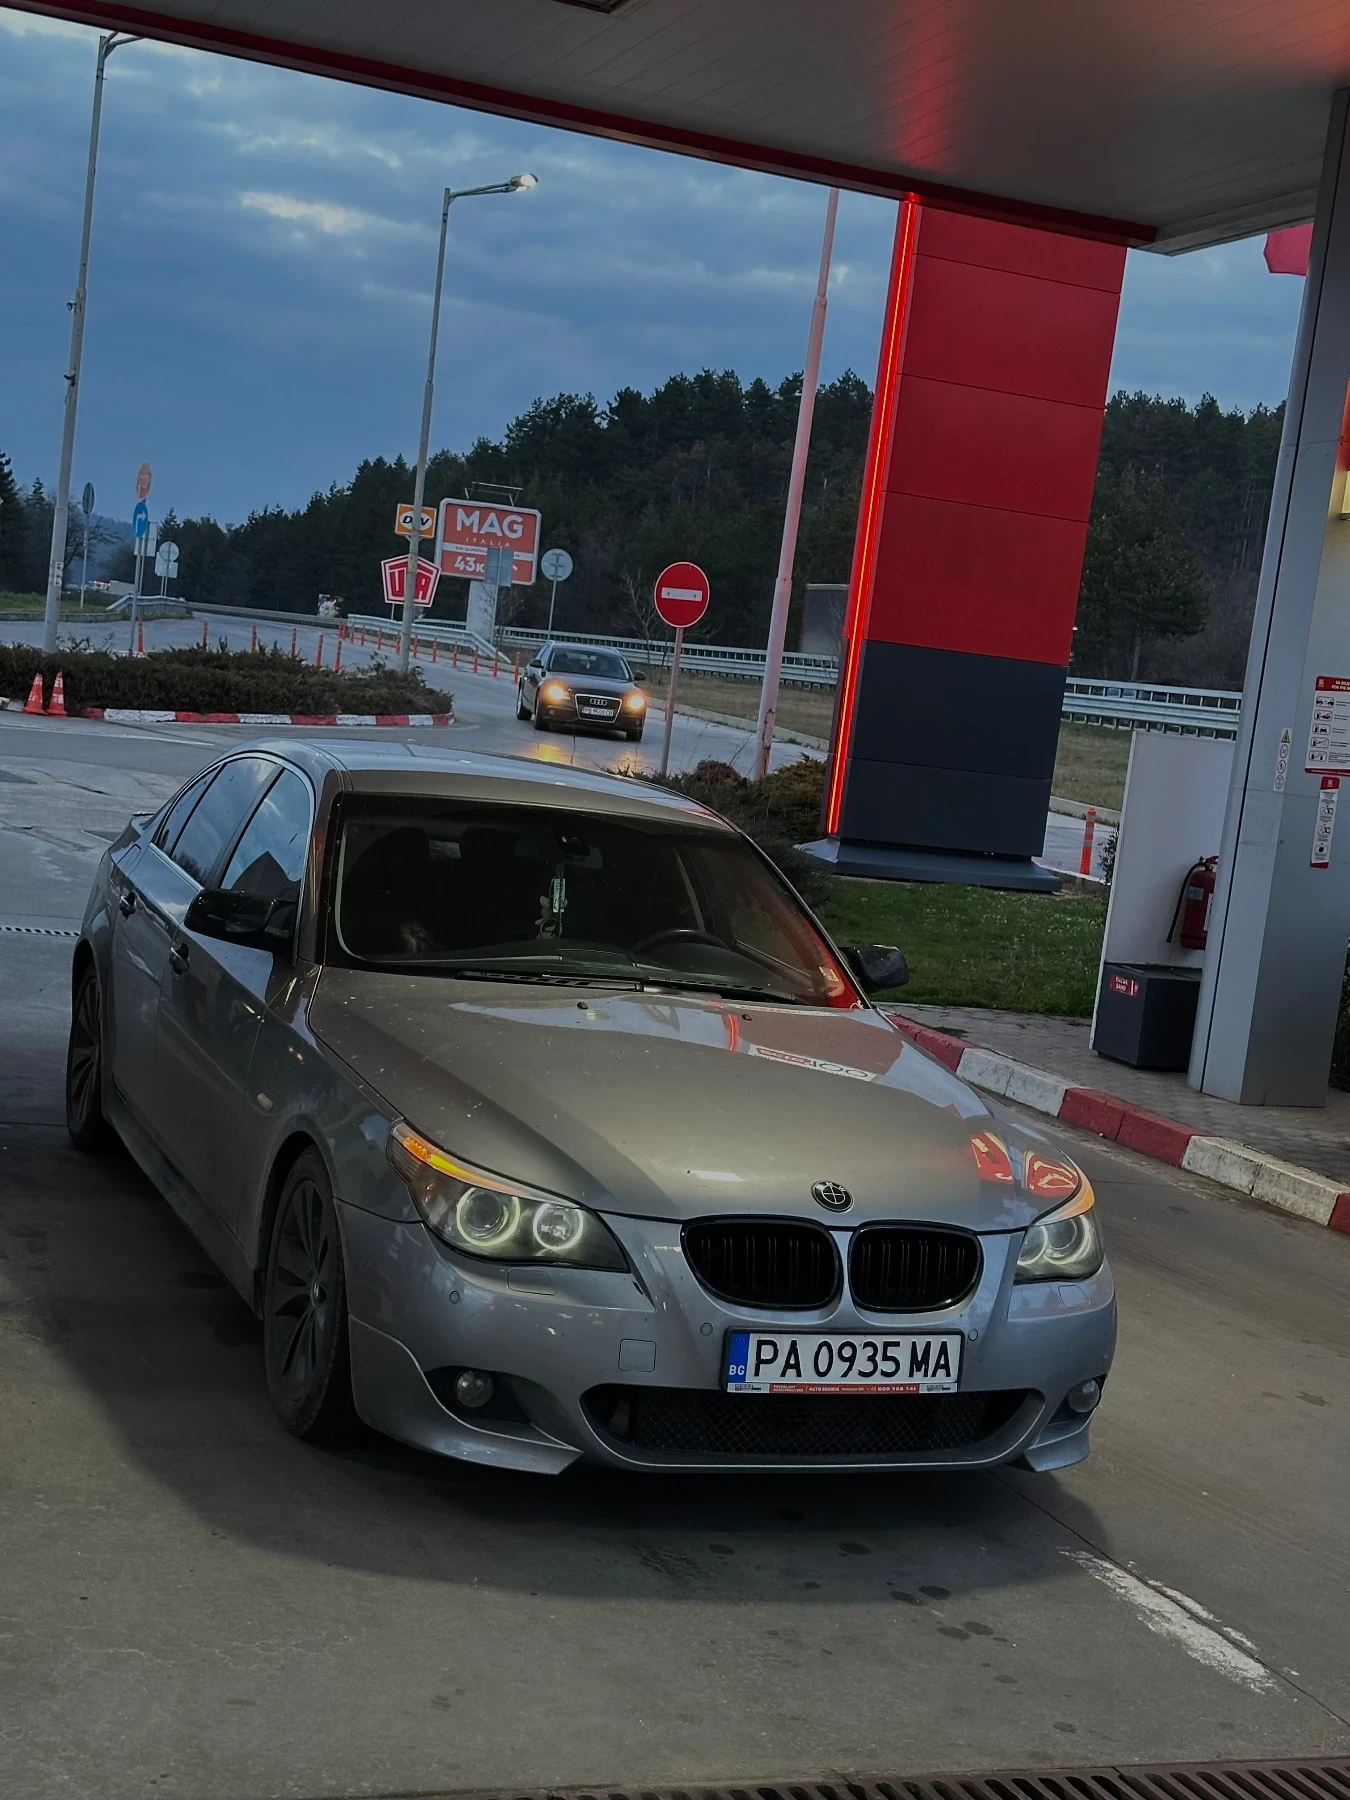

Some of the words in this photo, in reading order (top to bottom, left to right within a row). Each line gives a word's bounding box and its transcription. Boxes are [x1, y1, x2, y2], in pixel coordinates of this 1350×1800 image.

[402, 515, 430, 527] DV
[456, 508, 524, 539] MAG
[465, 537, 510, 548] ITALIA
[754, 1339, 802, 1377] PA
[813, 1340, 901, 1378] 0935
[908, 1340, 951, 1378] MA
[728, 1365, 746, 1376] BG
